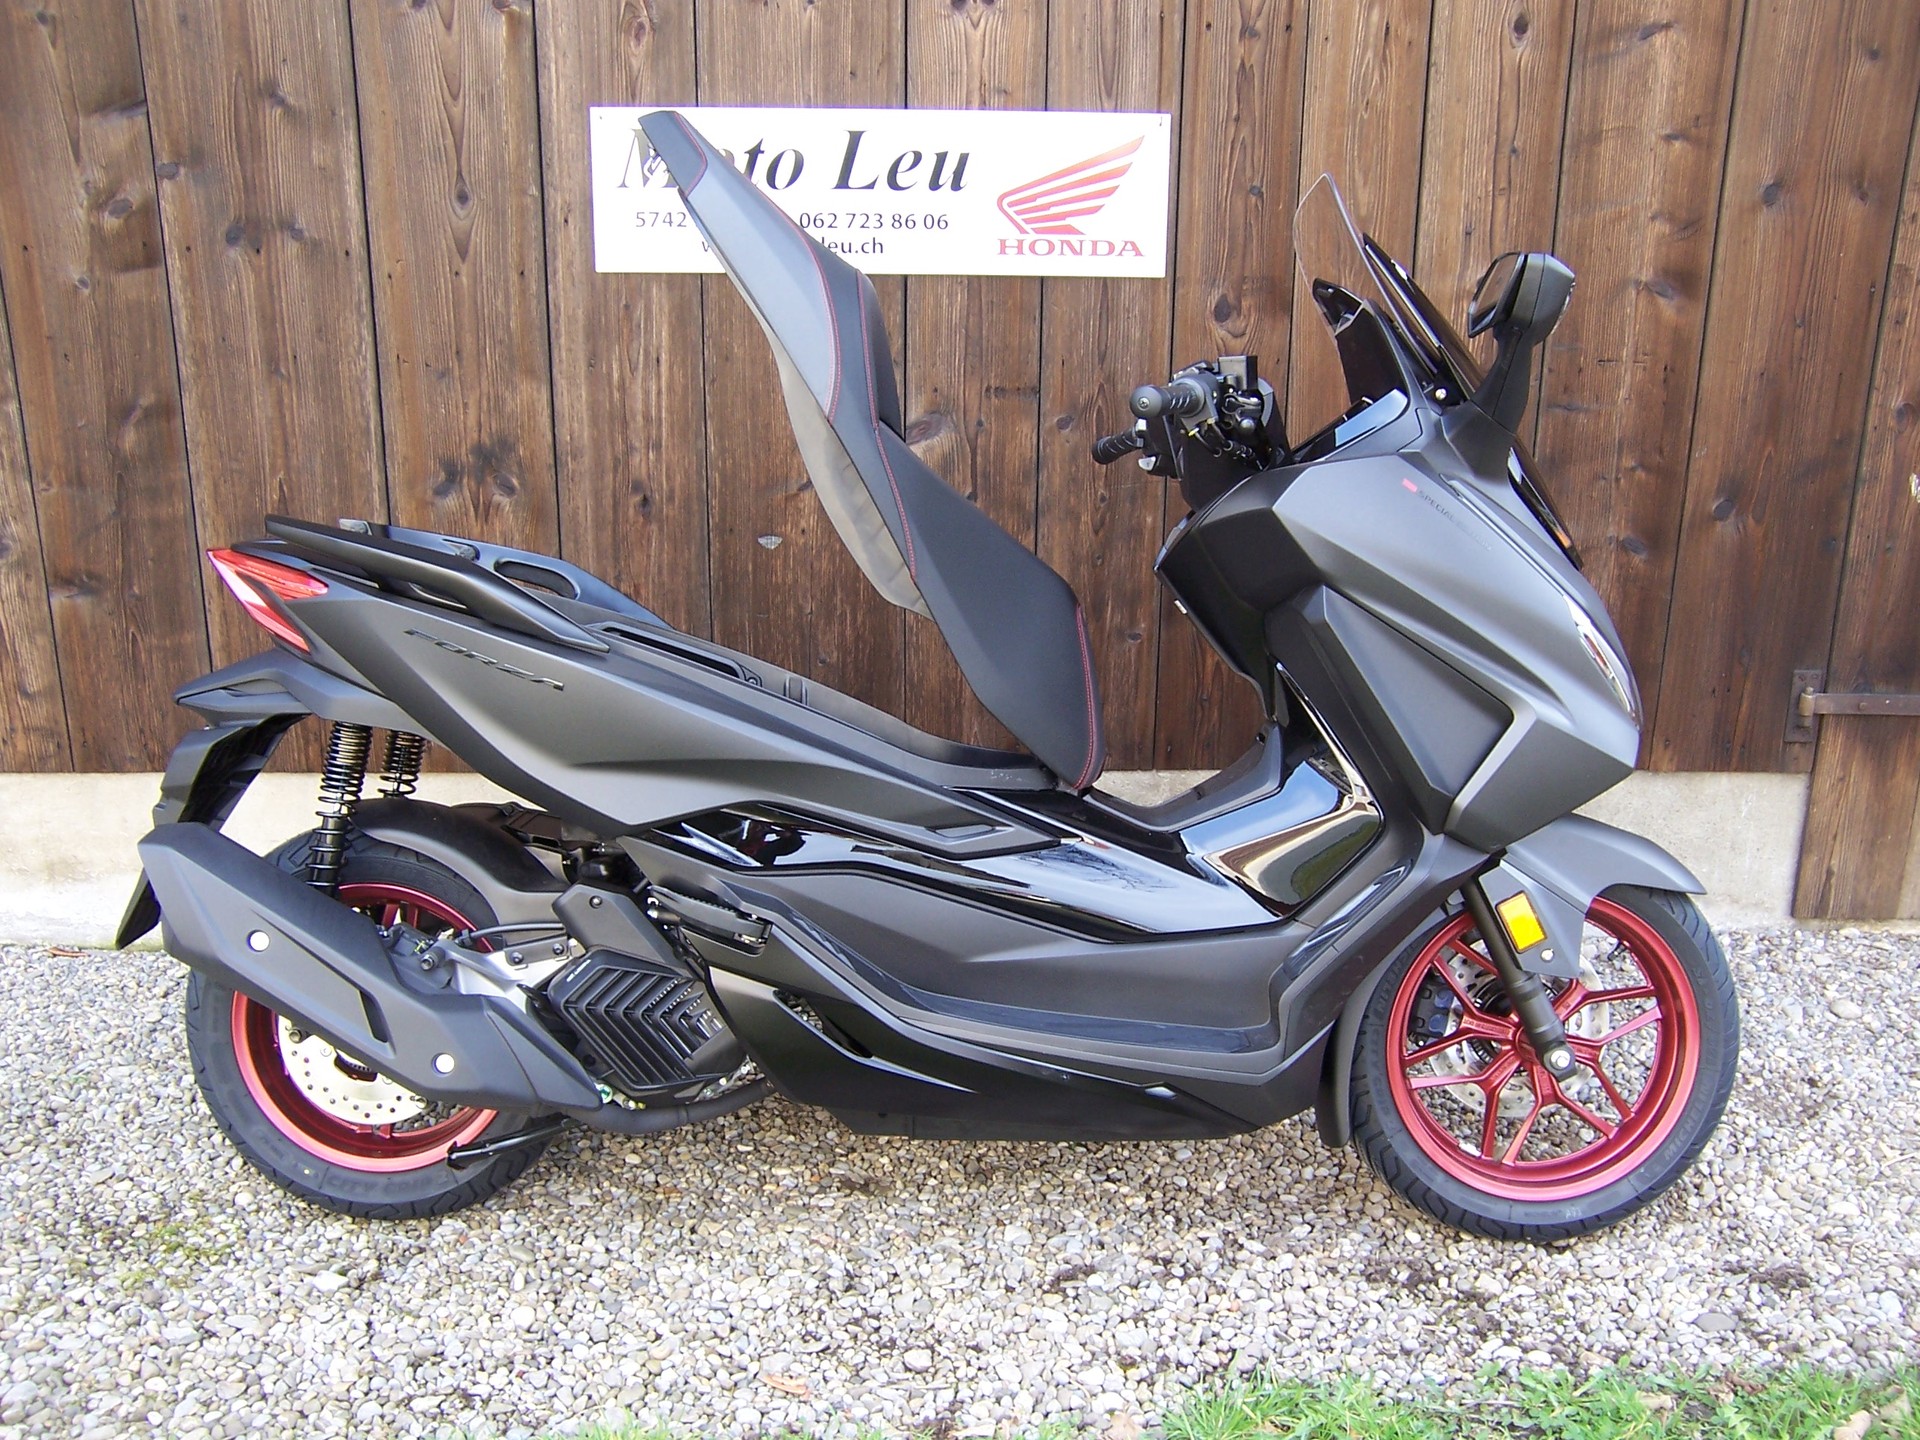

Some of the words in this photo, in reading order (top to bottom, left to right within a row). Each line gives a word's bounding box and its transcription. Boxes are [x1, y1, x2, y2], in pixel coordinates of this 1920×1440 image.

[832, 129, 970, 192] Leu
[635, 212, 688, 228] 5742
[799, 212, 838, 228] 062
[846, 213, 884, 229] 723
[891, 213, 917, 229] 86
[923, 213, 949, 230] 06
[996, 238, 1144, 258] HONDA
[403, 627, 566, 692] FORZA
